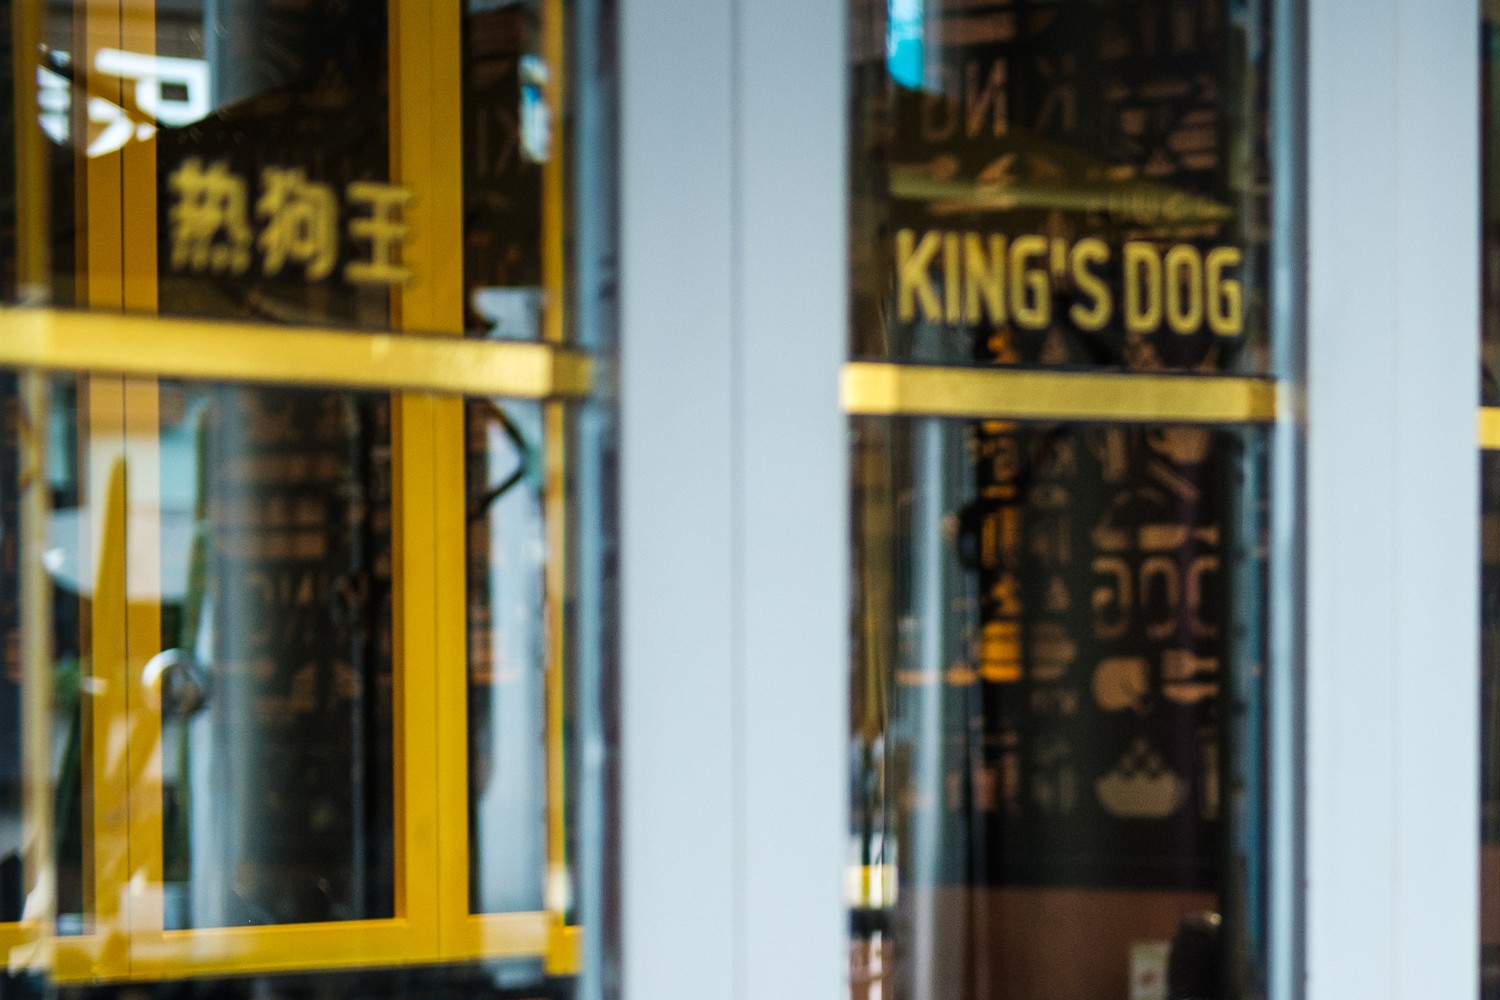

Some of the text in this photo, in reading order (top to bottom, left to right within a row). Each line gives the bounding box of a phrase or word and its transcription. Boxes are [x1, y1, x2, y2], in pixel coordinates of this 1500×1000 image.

[168, 158, 413, 285] 热狗王
[895, 227, 1244, 337] KING'S DOG
